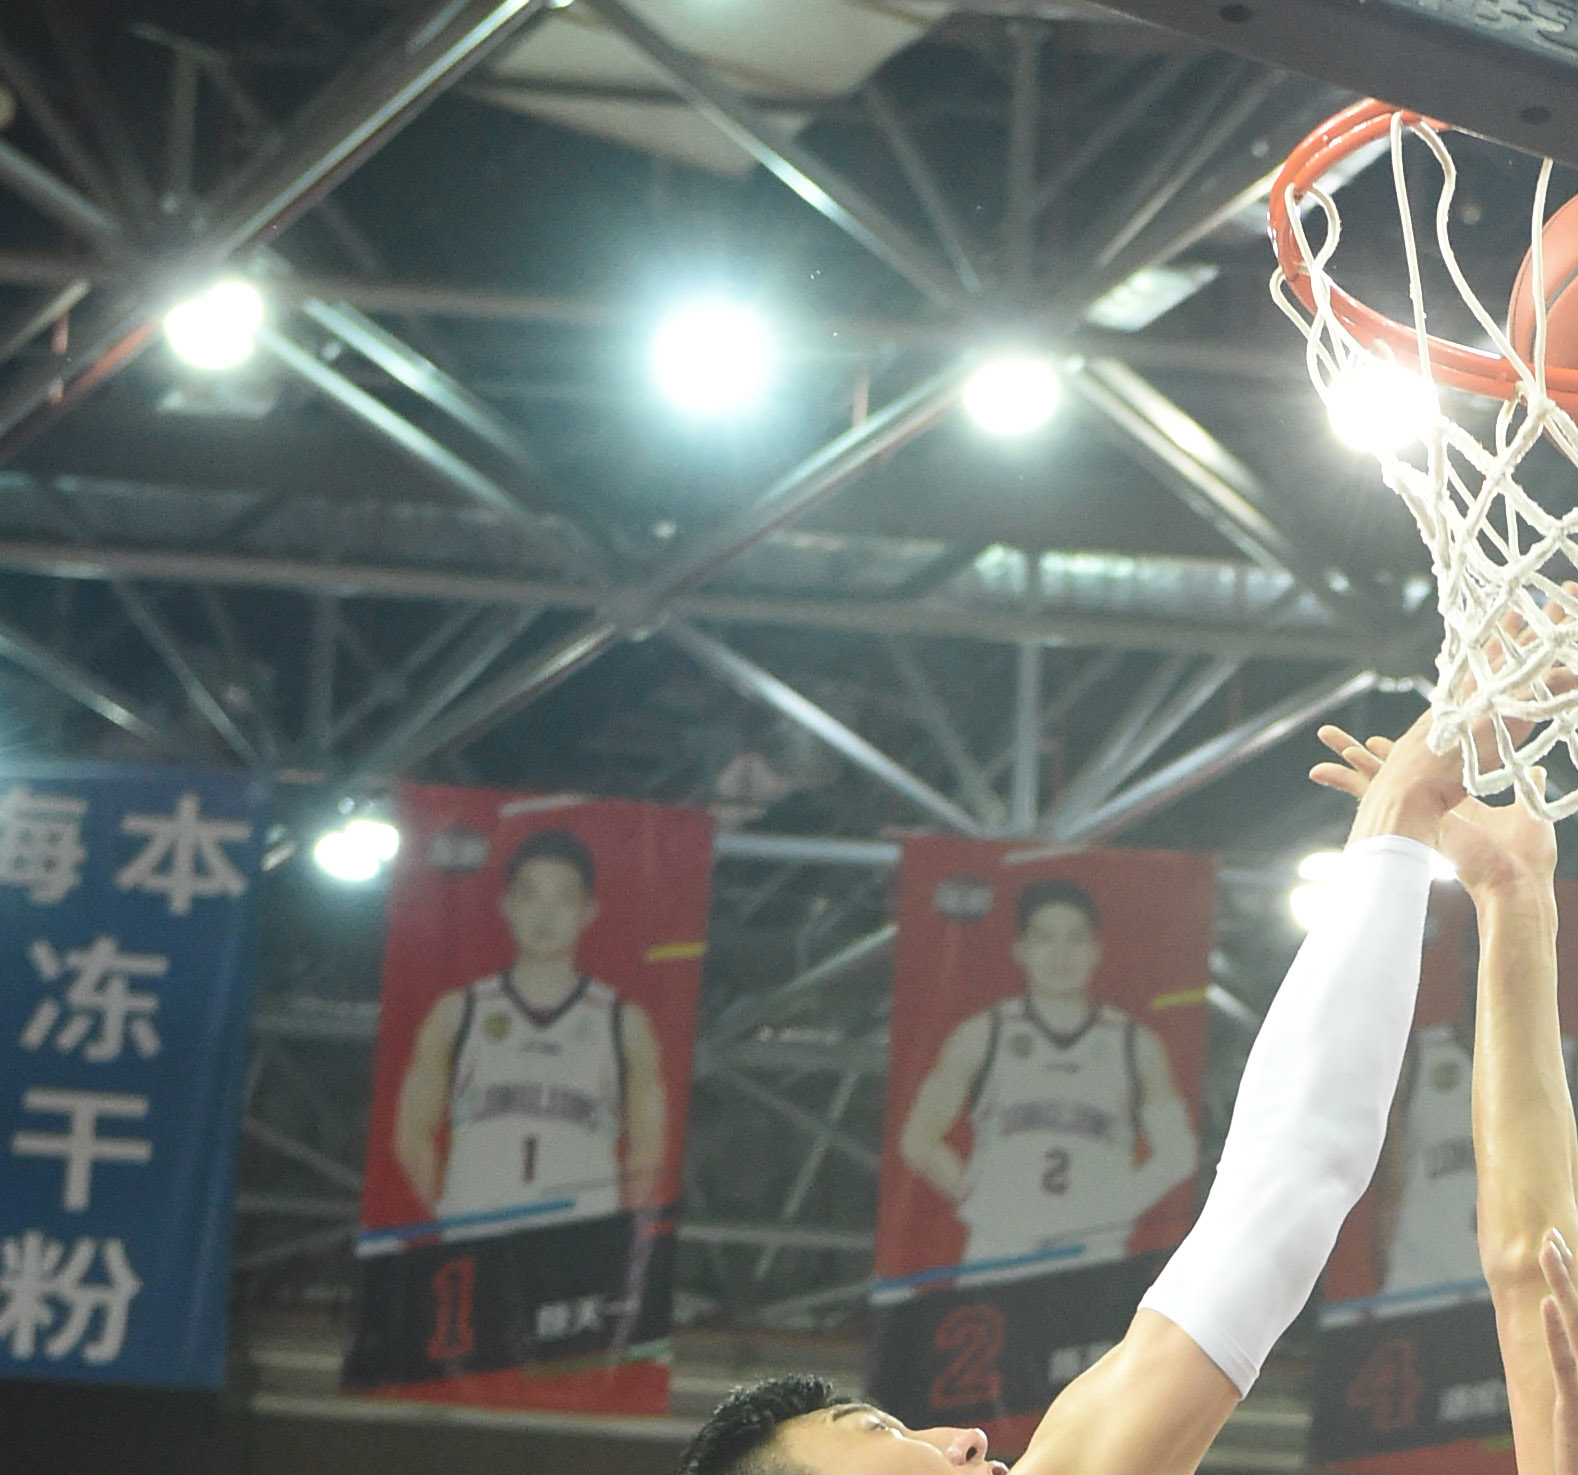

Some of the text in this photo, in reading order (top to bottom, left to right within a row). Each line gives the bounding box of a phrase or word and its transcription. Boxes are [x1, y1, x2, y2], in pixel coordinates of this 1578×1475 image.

[0, 934, 170, 1366] 冻干粉
[928, 1304, 1007, 1417] 2
[1345, 1339, 1424, 1432] 4
